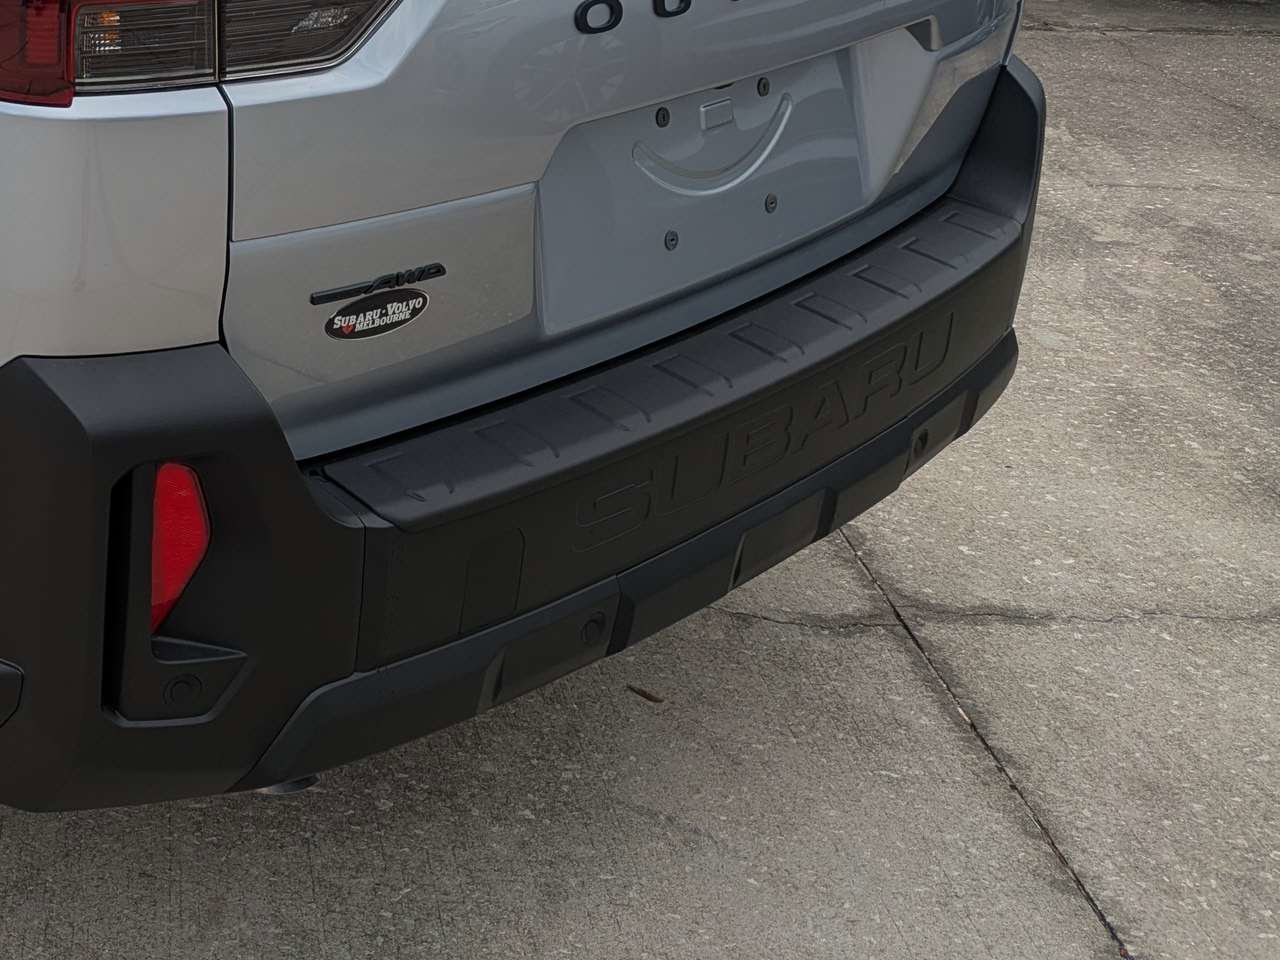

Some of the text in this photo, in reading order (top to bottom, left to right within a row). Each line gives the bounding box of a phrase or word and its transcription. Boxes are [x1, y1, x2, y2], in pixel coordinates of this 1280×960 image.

[362, 262, 447, 294] AWD
[354, 310, 413, 332] MELBOURNE
[568, 311, 955, 554] SUBARU
